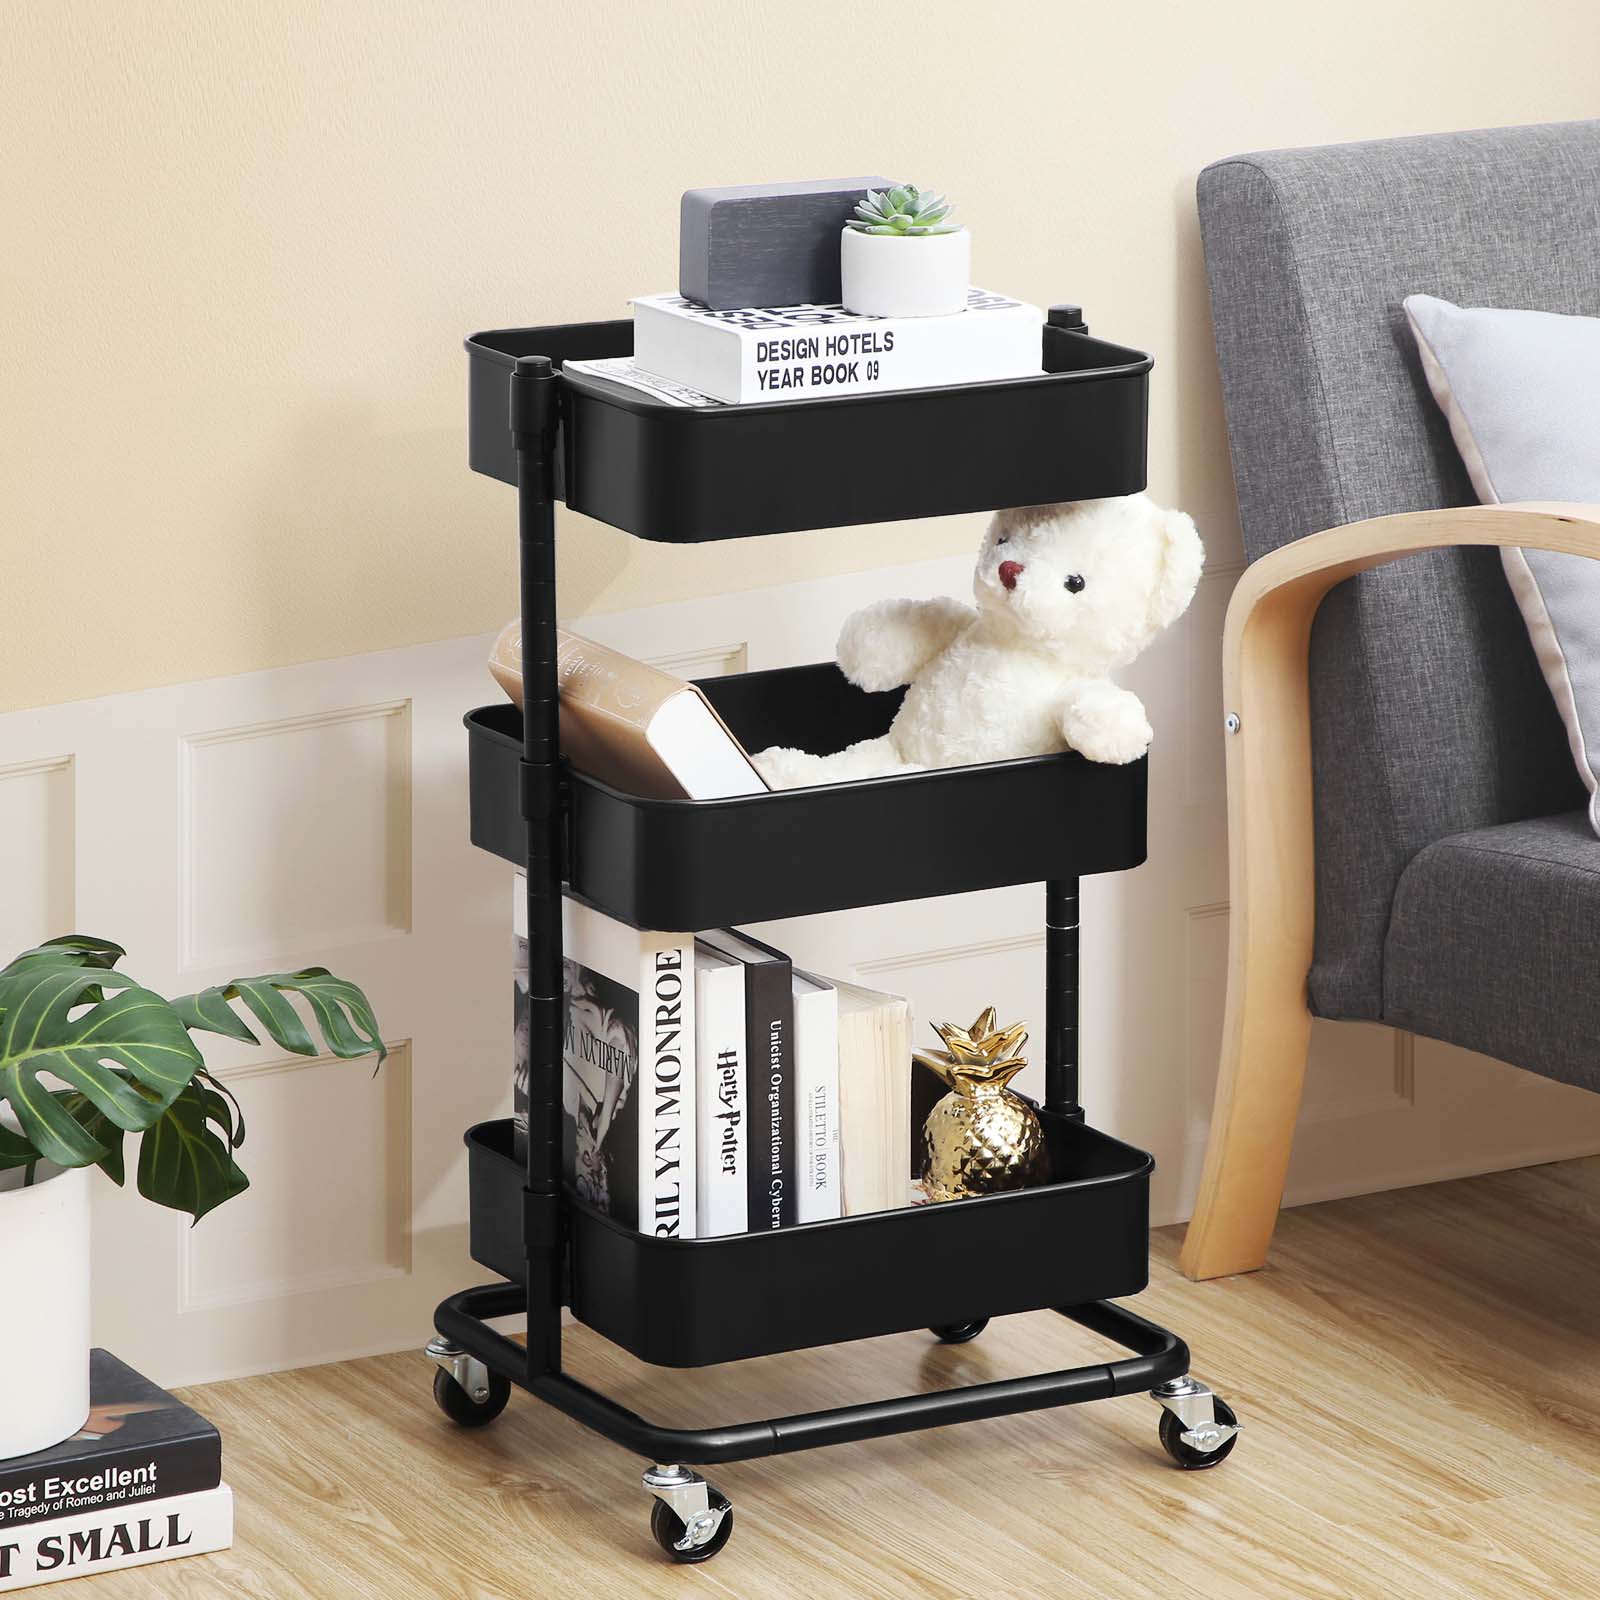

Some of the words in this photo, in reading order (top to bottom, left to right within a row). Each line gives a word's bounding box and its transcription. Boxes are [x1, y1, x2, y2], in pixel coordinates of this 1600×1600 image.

[757, 337, 819, 362] DESIGN
[826, 331, 894, 357] HOTELS
[758, 367, 804, 391] YEAR
[811, 362, 859, 386] BOOK
[867, 360, 879, 381] 09
[579, 1029, 633, 1084] MARILYN
[655, 949, 682, 1117] MONROE
[770, 1020, 782, 1070] Unicist
[717, 1049, 739, 1109] Harry
[768, 1073, 783, 1175] Organizational
[815, 1085, 827, 1147] STILETTO
[714, 1110, 741, 1176] Potter
[815, 1153, 827, 1191] BOOK
[769, 1178, 783, 1229] Cybern
[7, 1502, 51, 1519] Tragedy
[52, 1498, 64, 1511] of
[66, 1494, 104, 1509] Romeo
[106, 1488, 126, 1502] and
[128, 1483, 156, 1498] Juliet
[44, 1462, 157, 1500] Excellent
[36, 1513, 193, 1571] SMALL
